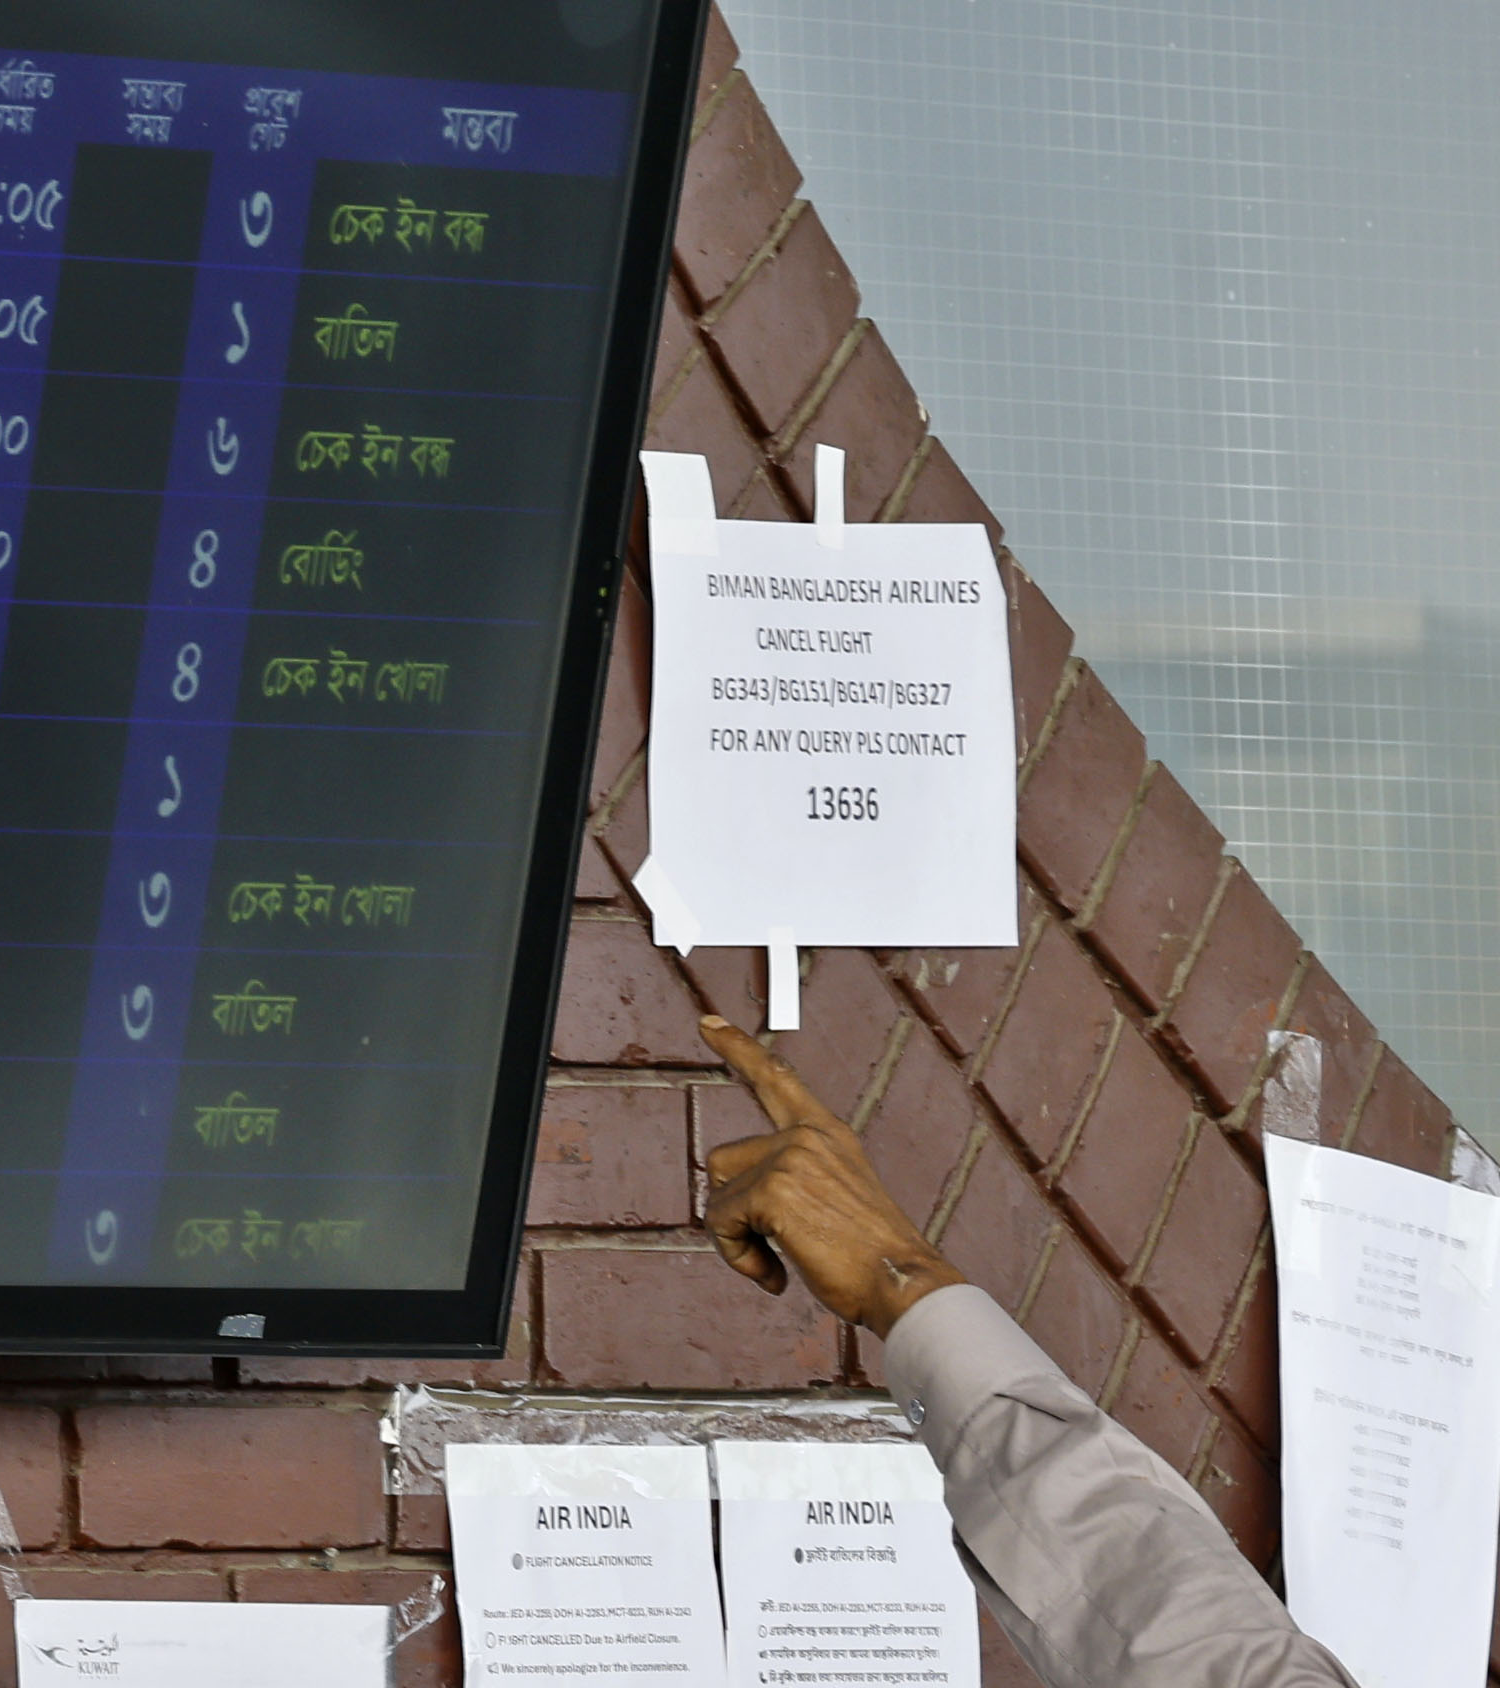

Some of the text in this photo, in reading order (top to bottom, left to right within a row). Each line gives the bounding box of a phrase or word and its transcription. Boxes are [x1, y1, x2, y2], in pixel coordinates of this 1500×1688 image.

[127, 113, 172, 141] সময়
[250, 121, 289, 150] গেট
[442, 107, 518, 150] মন্তব্য
[242, 192, 272, 247] ৩
[331, 198, 489, 250] চেক ইন বন্ধ
[226, 302, 249, 363] ১
[314, 303, 399, 360] বাতিল
[209, 417, 238, 475] ৬
[298, 424, 455, 475] চেক ইন বন্ধ
[189, 529, 218, 588] ৪
[281, 529, 363, 589] বোর্ডিং
[708, 574, 980, 603] BIMAN BANGLADESH AIRLINES
[758, 628, 872, 653] CANCEL FLIGHT
[172, 643, 201, 701] ৪
[263, 649, 449, 701] চেক ইন খোলা
[713, 677, 951, 708] BG343/BG151/BG147/BG327
[712, 729, 966, 755] FOR ANY QUERY PLS CONTACT
[158, 756, 181, 817] ১
[808, 787, 878, 820] 13636
[140, 873, 170, 928] ৩
[230, 874, 416, 925] চেক ইন খোলা
[123, 985, 153, 1040] ৩
[212, 979, 297, 1033] বাতিল
[194, 1091, 280, 1146] বাতিল
[86, 1210, 117, 1264] ৩
[538, 1506, 631, 1529] AIR INDIA
[807, 1502, 893, 1524] AIR INDIA
[78, 1662, 119, 1674] KUWAIT
